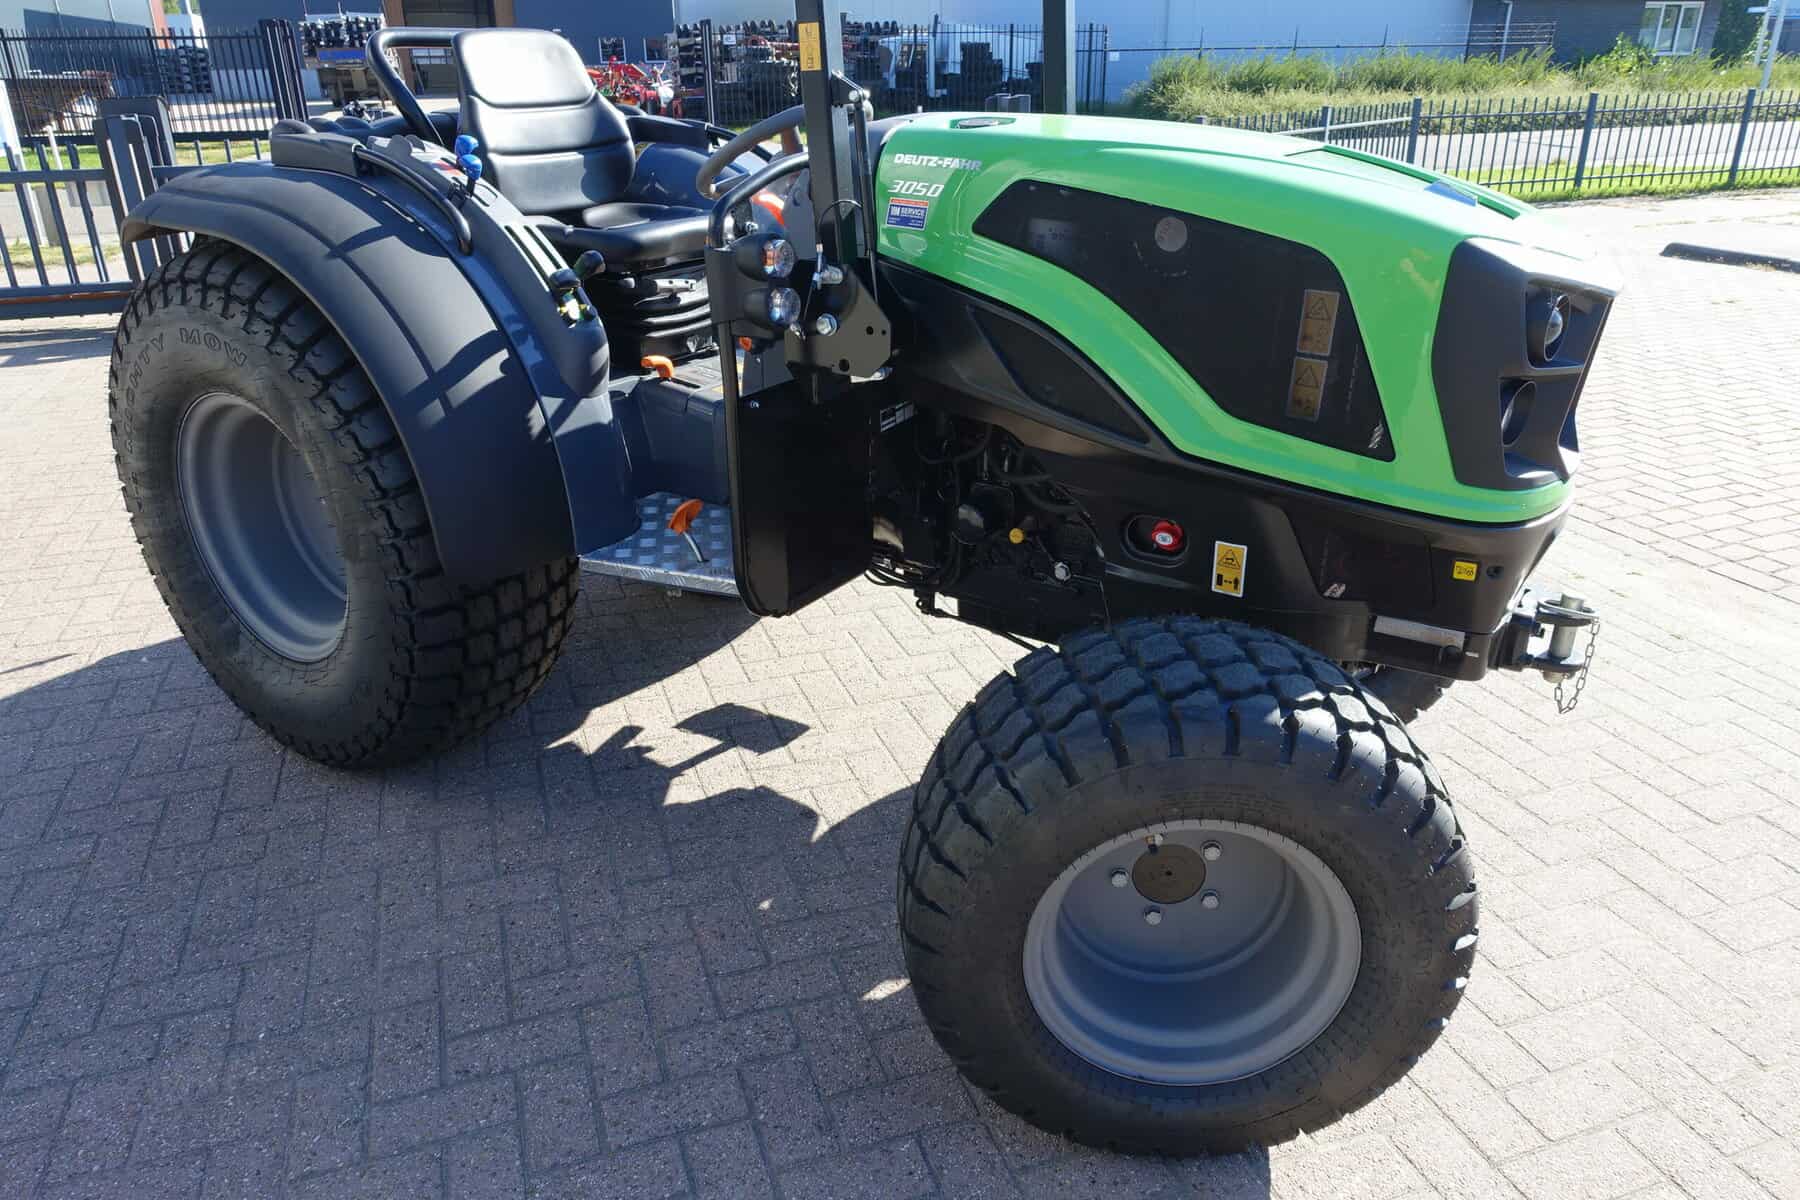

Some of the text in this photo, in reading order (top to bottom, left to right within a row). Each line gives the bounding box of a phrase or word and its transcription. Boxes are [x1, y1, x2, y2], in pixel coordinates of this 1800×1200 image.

[894, 154, 982, 170] DEUTZ-FAHR
[888, 180, 944, 197] 3050
[179, 327, 247, 367] MOW
